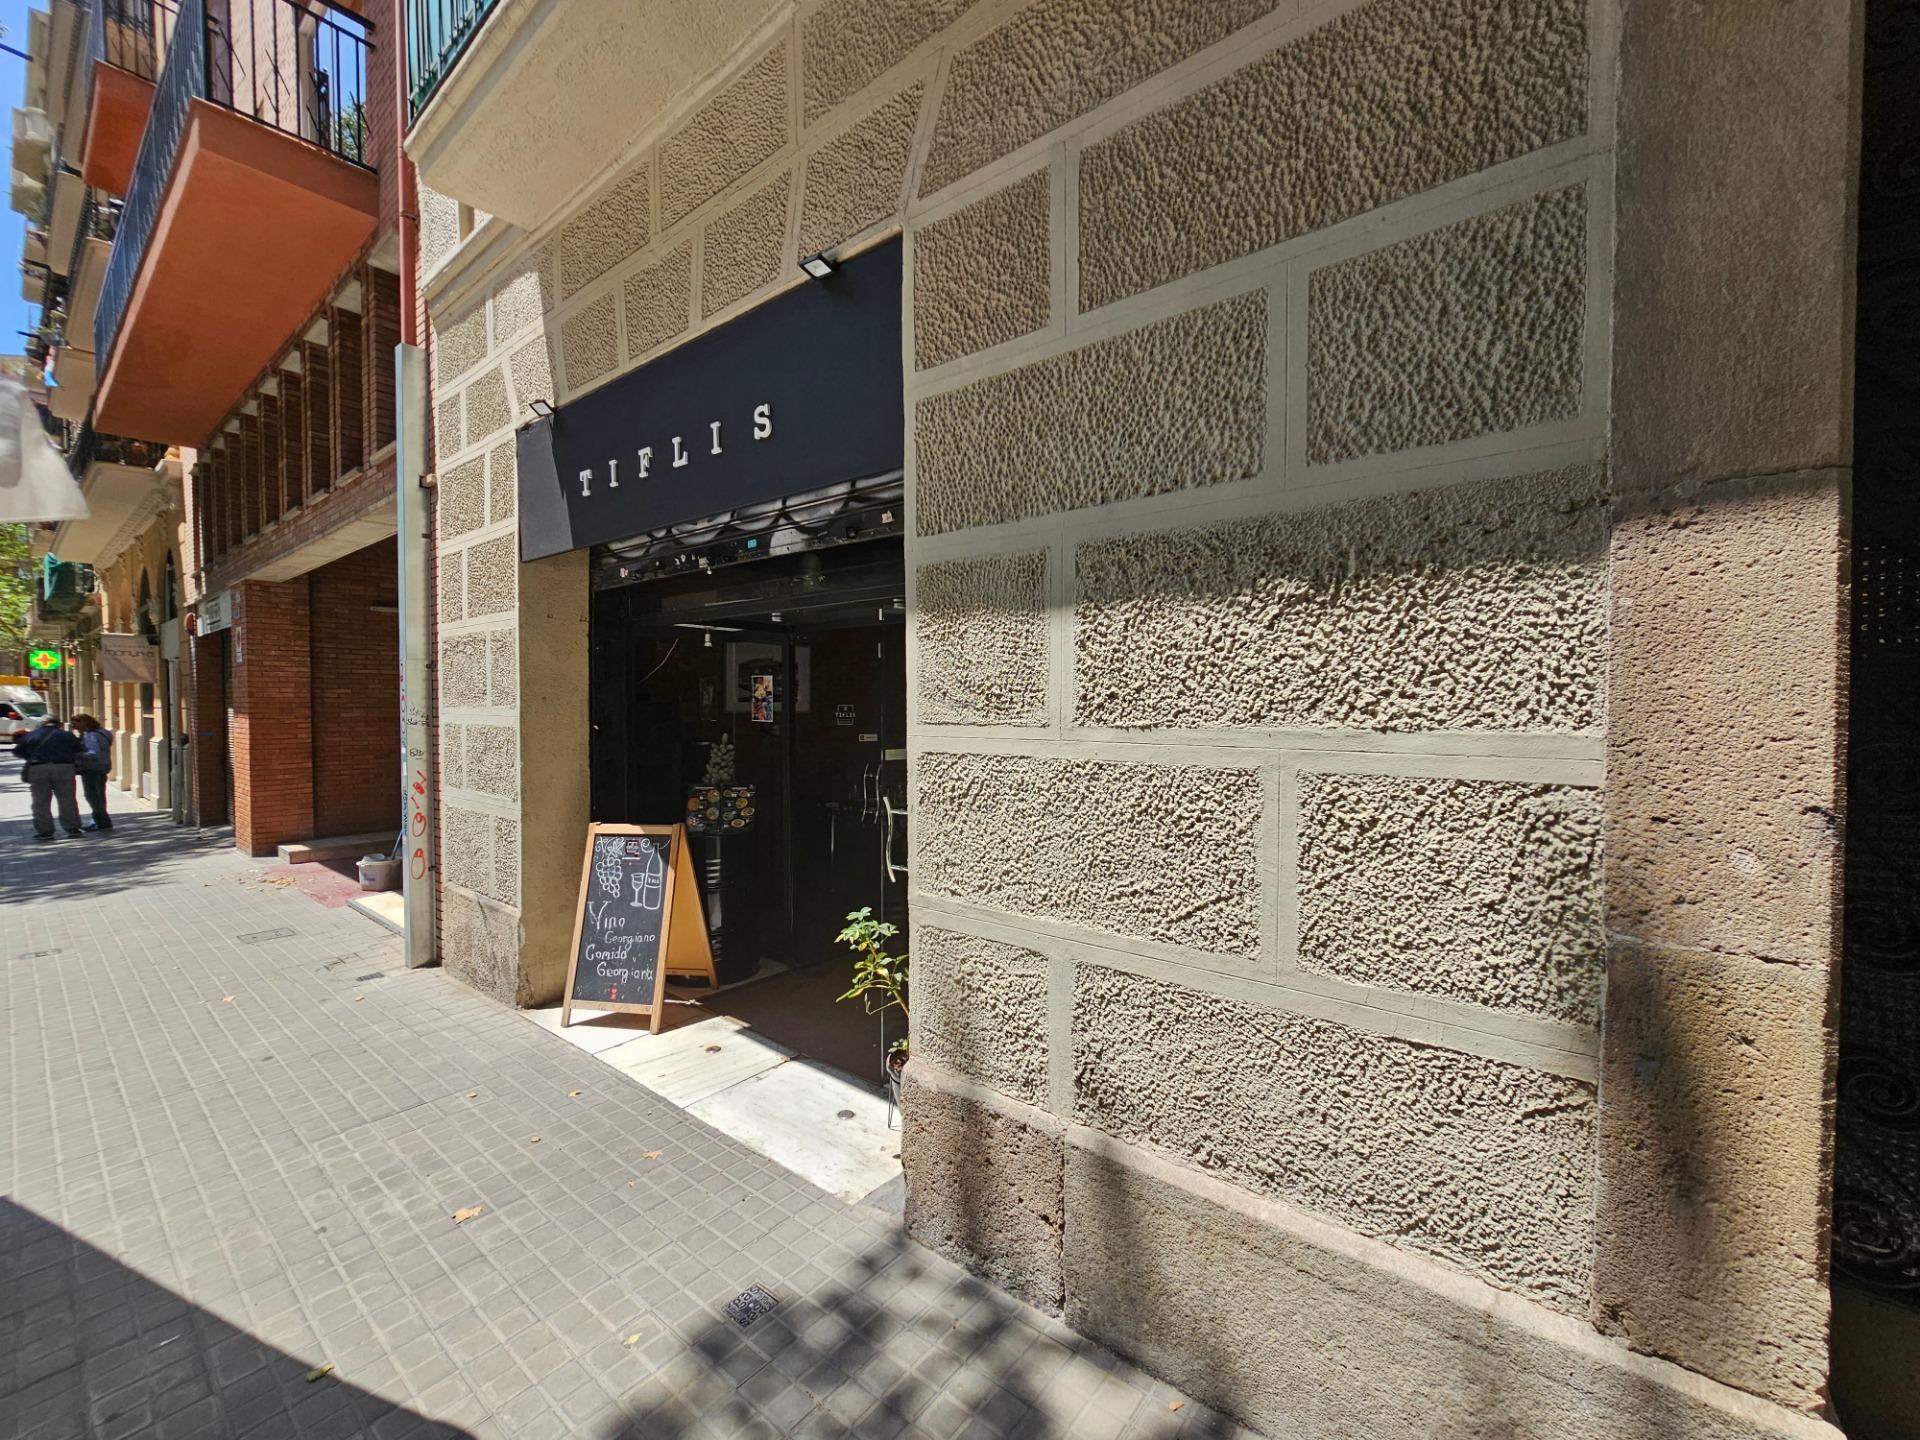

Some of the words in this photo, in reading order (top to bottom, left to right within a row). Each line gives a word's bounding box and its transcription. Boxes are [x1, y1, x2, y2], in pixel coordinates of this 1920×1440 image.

[579, 403, 774, 497] TIFLIS
[586, 944, 627, 960] Comida
[605, 931, 655, 952] Georgiano
[597, 962, 653, 984] Georgiana
